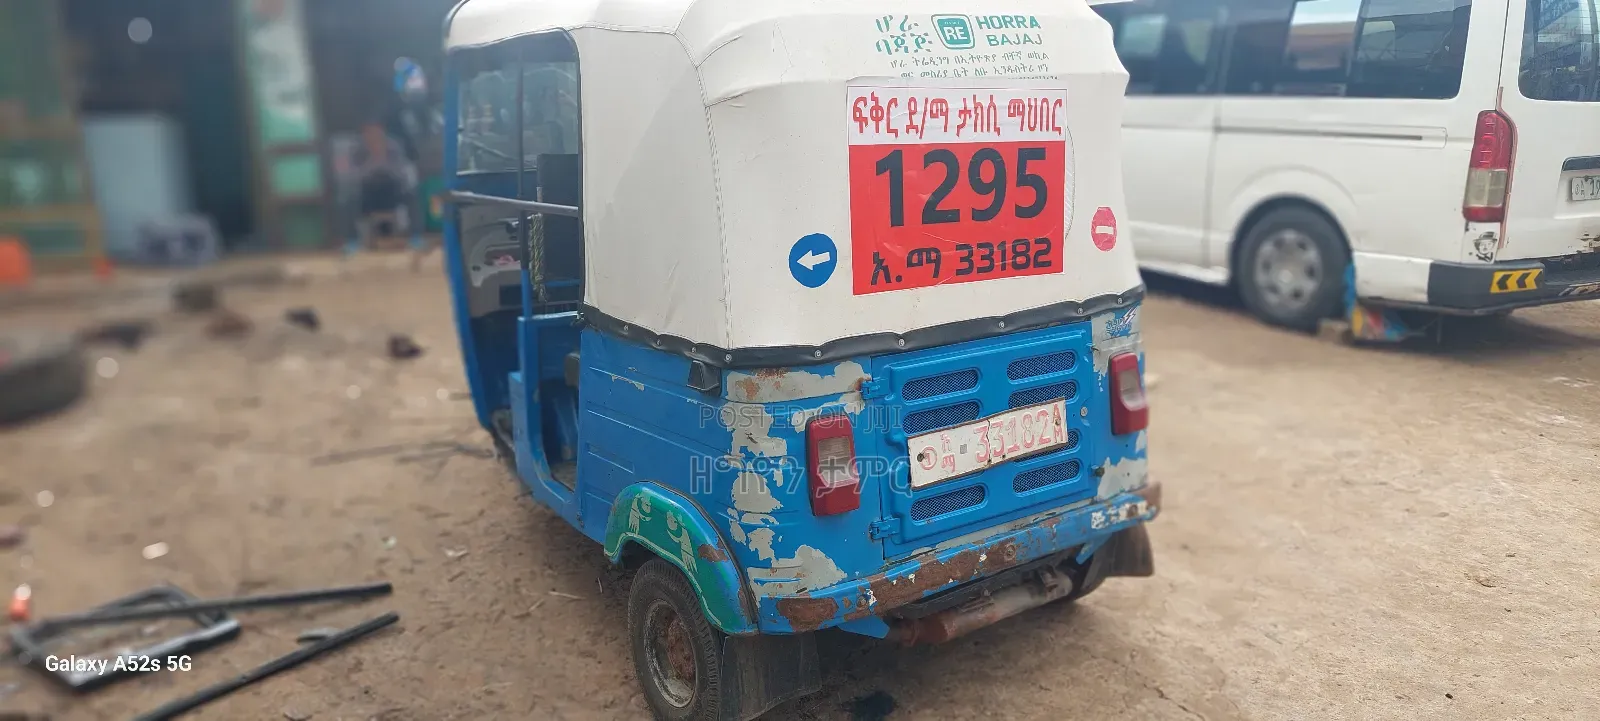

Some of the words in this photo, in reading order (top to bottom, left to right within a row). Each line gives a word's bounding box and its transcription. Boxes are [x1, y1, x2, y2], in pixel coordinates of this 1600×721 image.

[943, 26, 968, 41] RE
[975, 14, 1042, 30] HORRA
[986, 34, 1043, 47] BAJAJ
[852, 91, 898, 138] ፍቅር
[956, 94, 1001, 137] ታክሲ
[1007, 97, 1063, 136] ማህበር
[875, 147, 1048, 228] 1295
[955, 237, 1052, 277] 33182
[974, 409, 1051, 464] 33182
